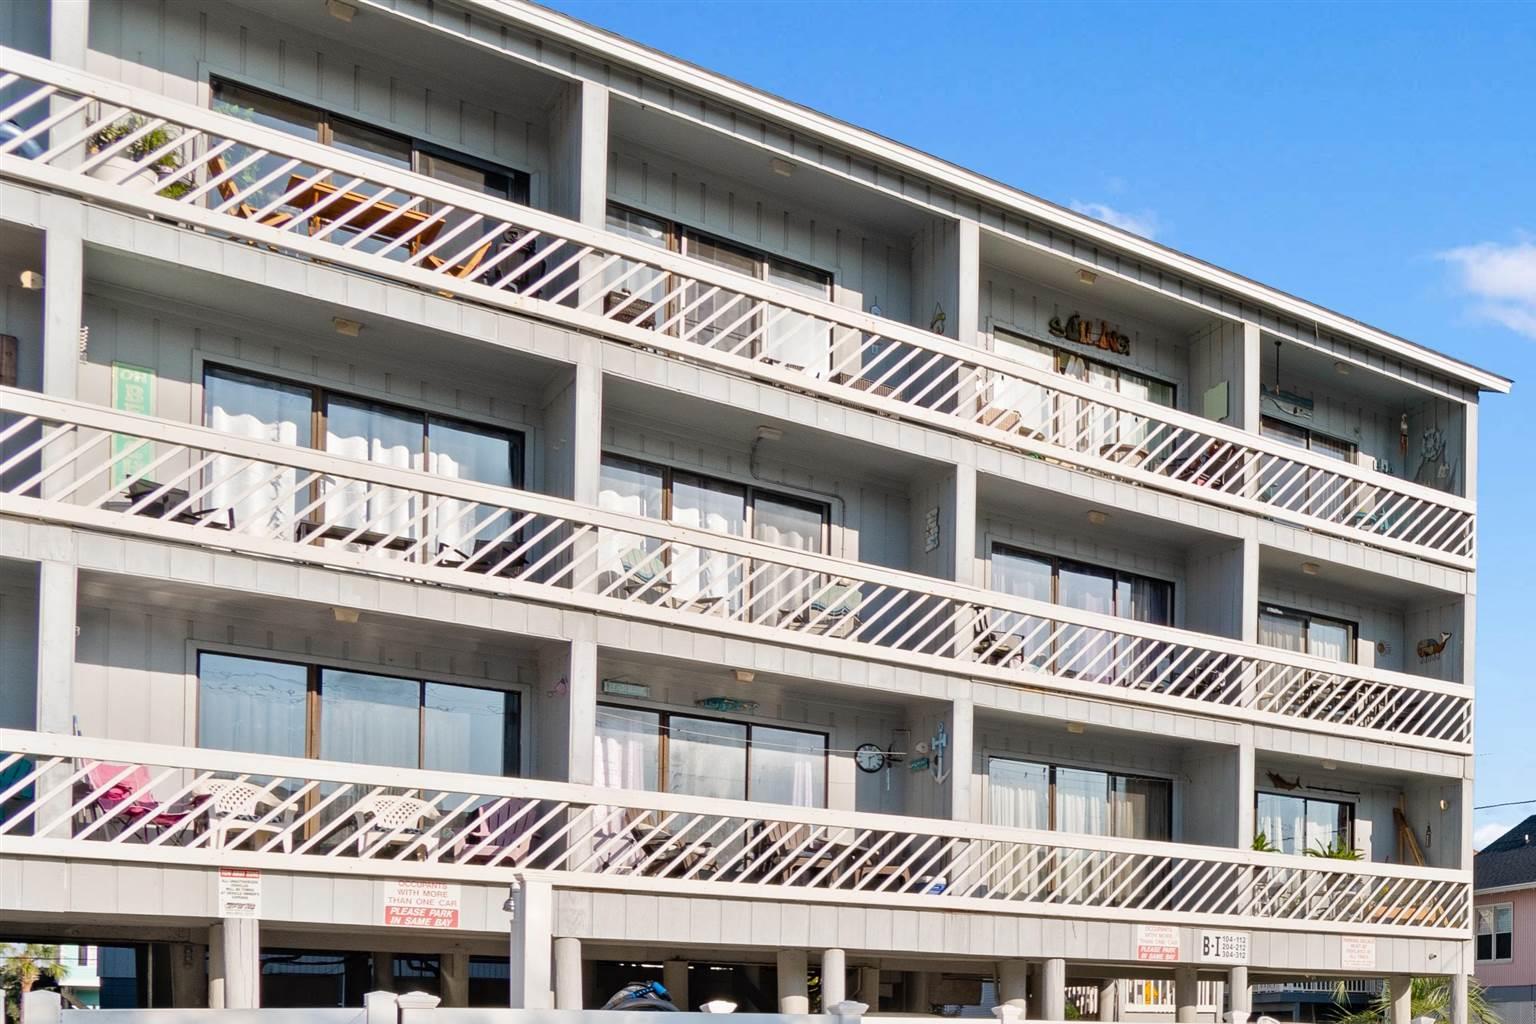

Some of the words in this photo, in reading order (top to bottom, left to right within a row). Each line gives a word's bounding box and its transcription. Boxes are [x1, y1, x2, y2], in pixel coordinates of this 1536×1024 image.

[397, 888, 419, 896] WITH
[423, 890, 448, 898] MORE
[388, 896, 412, 904] THAN
[438, 899, 457, 907] CAR
[390, 907, 426, 916] PLEASE
[429, 909, 453, 917] PARK
[404, 917, 433, 926] SAME
[435, 919, 453, 927] BAY
[1222, 935, 1246, 943] 104-112
[1222, 951, 1246, 959] 304-312
